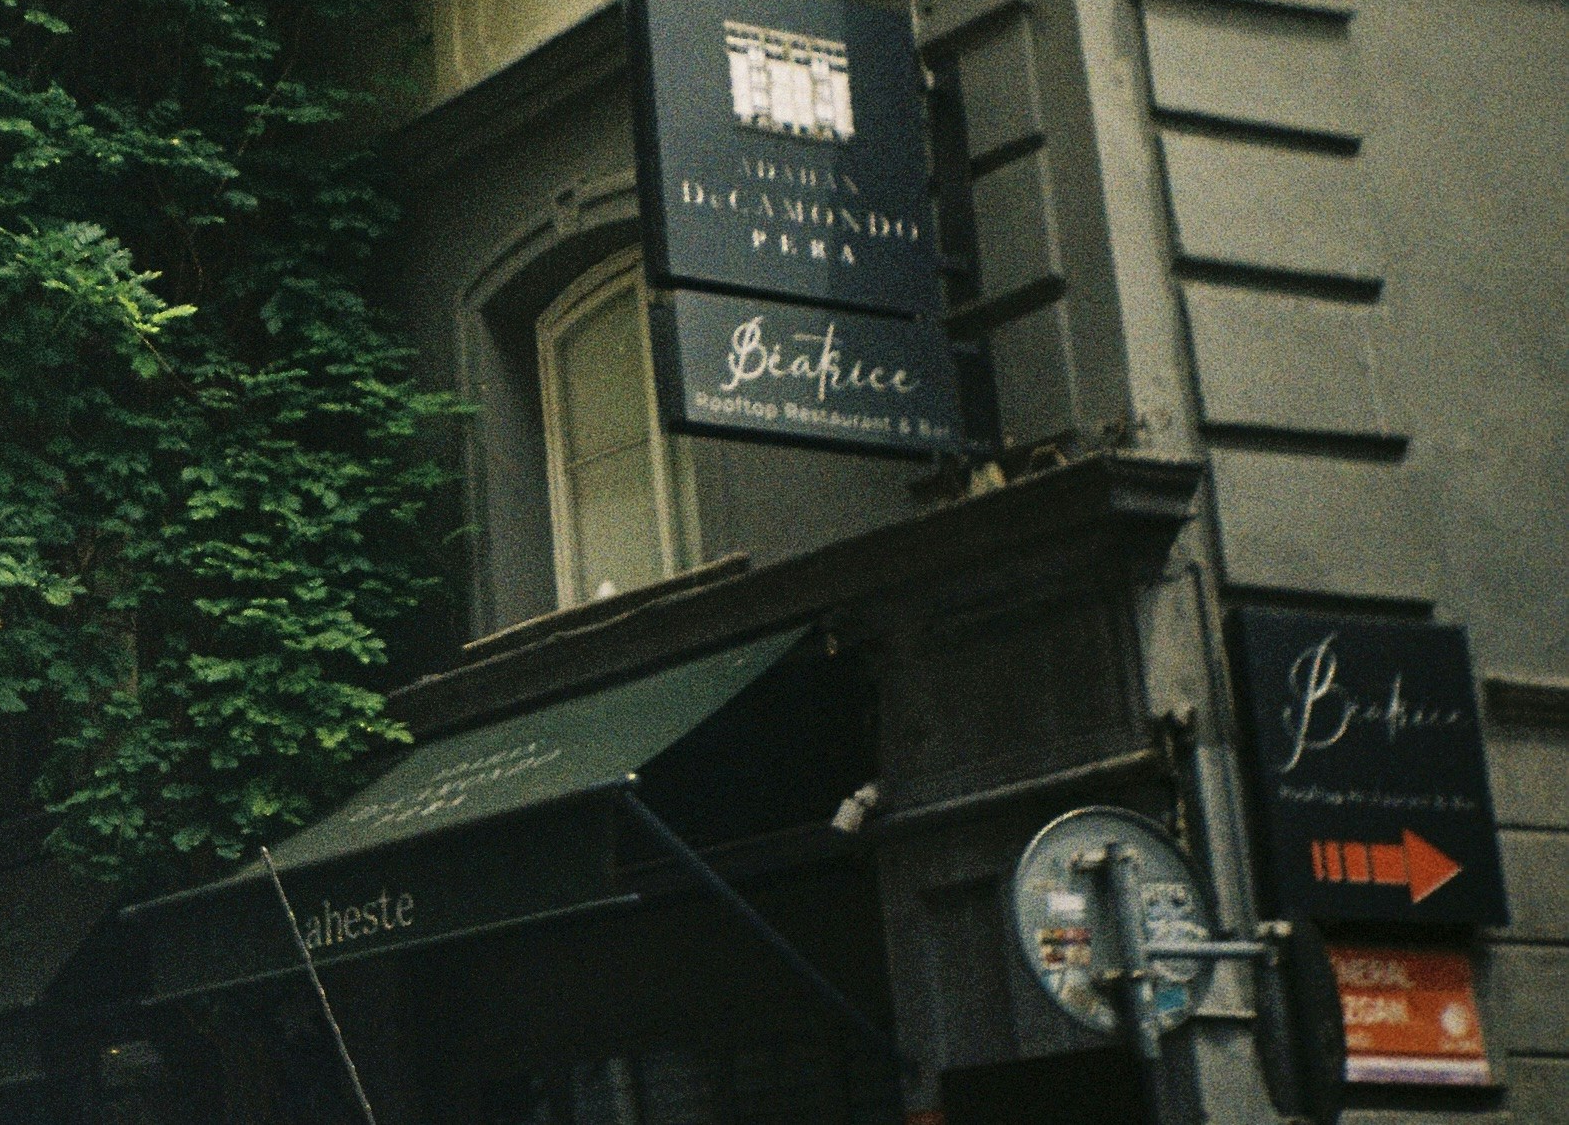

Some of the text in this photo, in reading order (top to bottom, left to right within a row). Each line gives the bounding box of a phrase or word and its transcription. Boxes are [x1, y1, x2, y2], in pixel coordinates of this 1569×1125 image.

[750, 227, 856, 266] PERA
[694, 390, 778, 420] Rooftop
[784, 402, 892, 433] Restaurant
[303, 886, 416, 951] aheste
